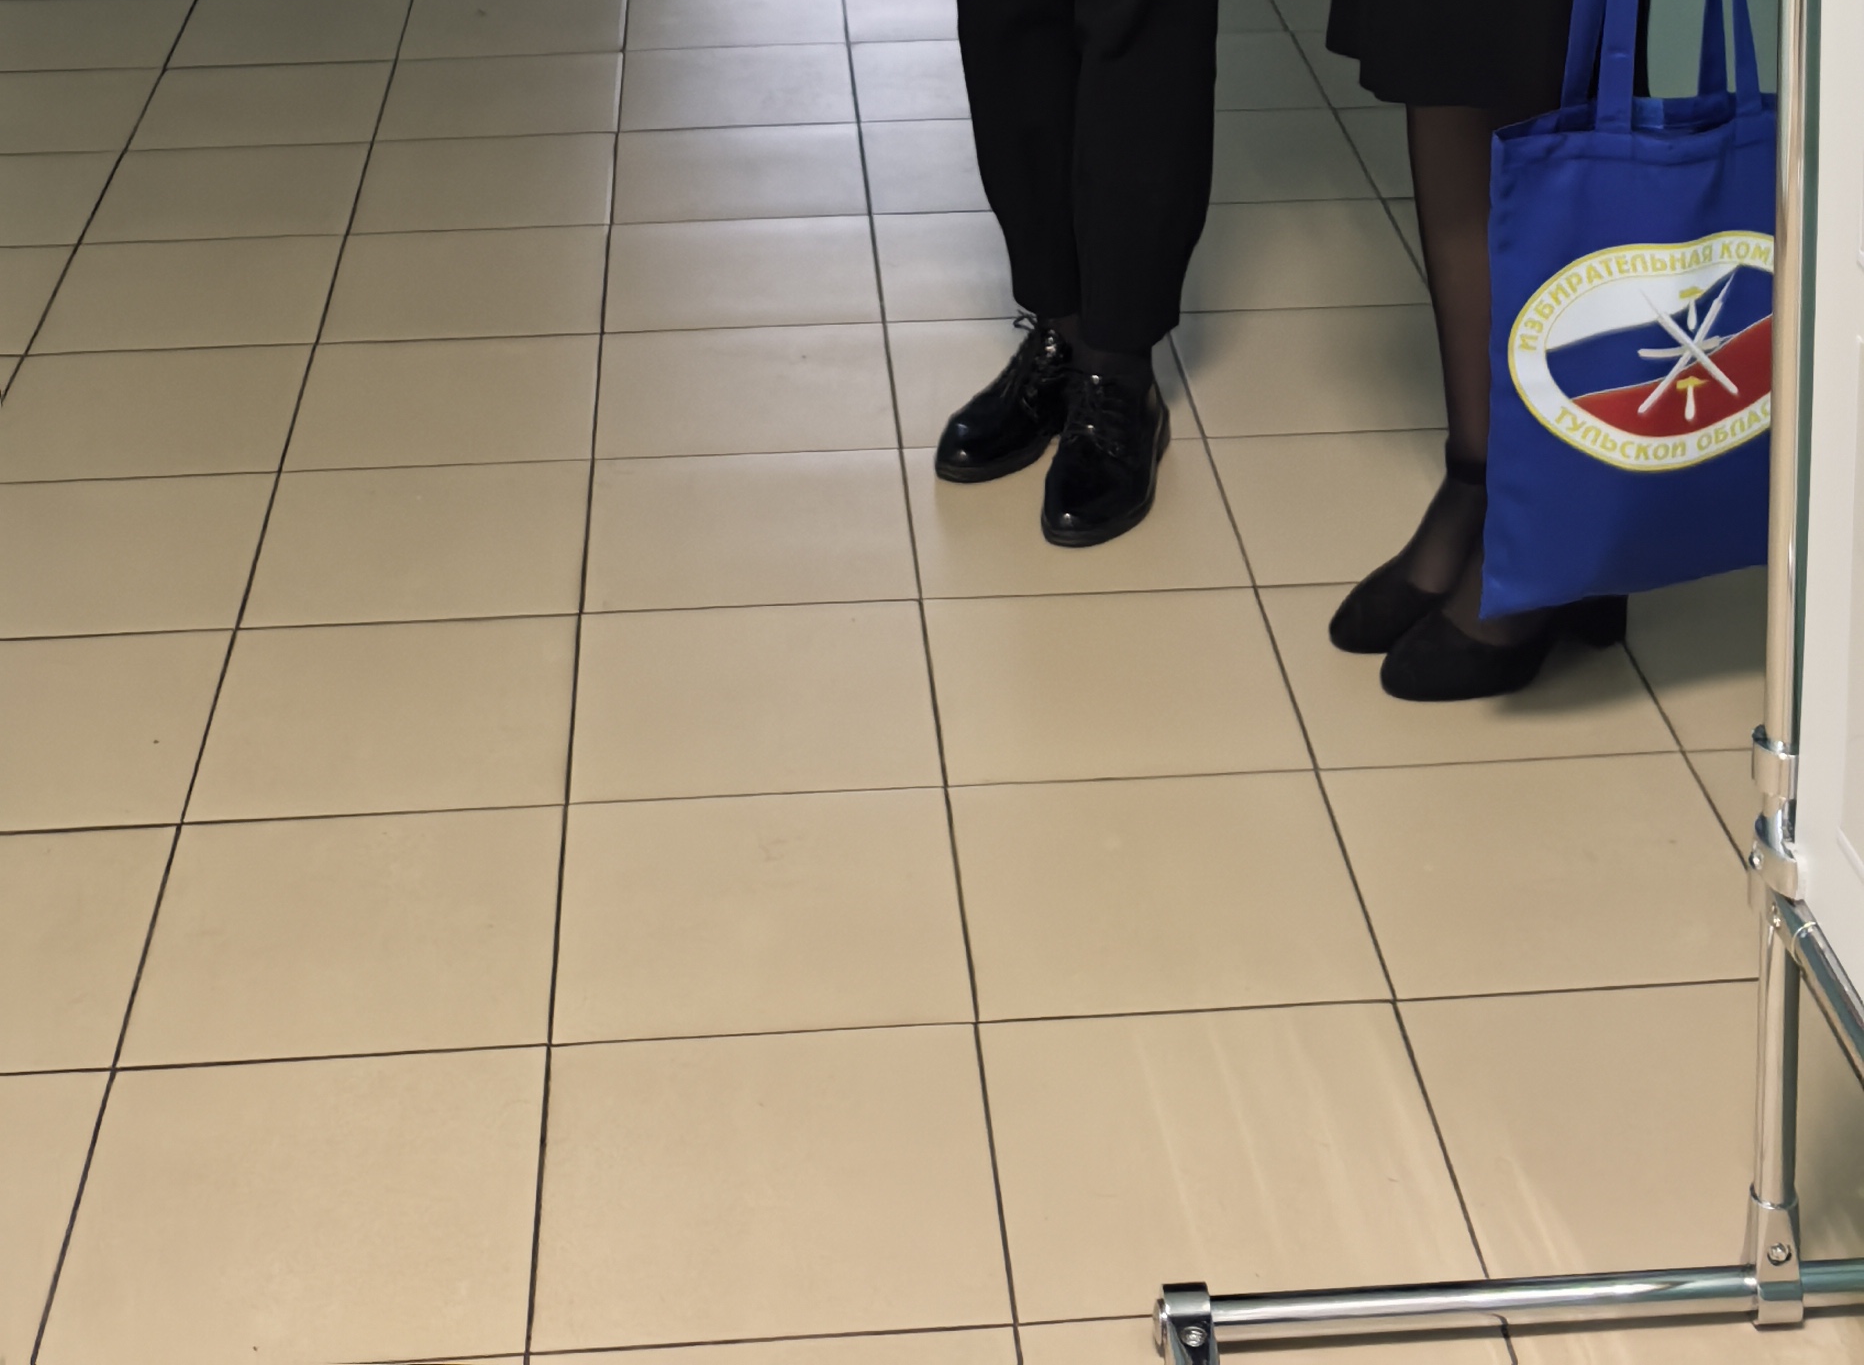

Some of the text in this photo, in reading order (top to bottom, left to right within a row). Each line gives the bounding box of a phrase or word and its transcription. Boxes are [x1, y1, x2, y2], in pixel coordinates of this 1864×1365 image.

[1517, 240, 1774, 352] ИЗБИРАТЕЛЬНАЯ КОМ
[1553, 405, 1687, 462] ТУЛЬСКОЙ
